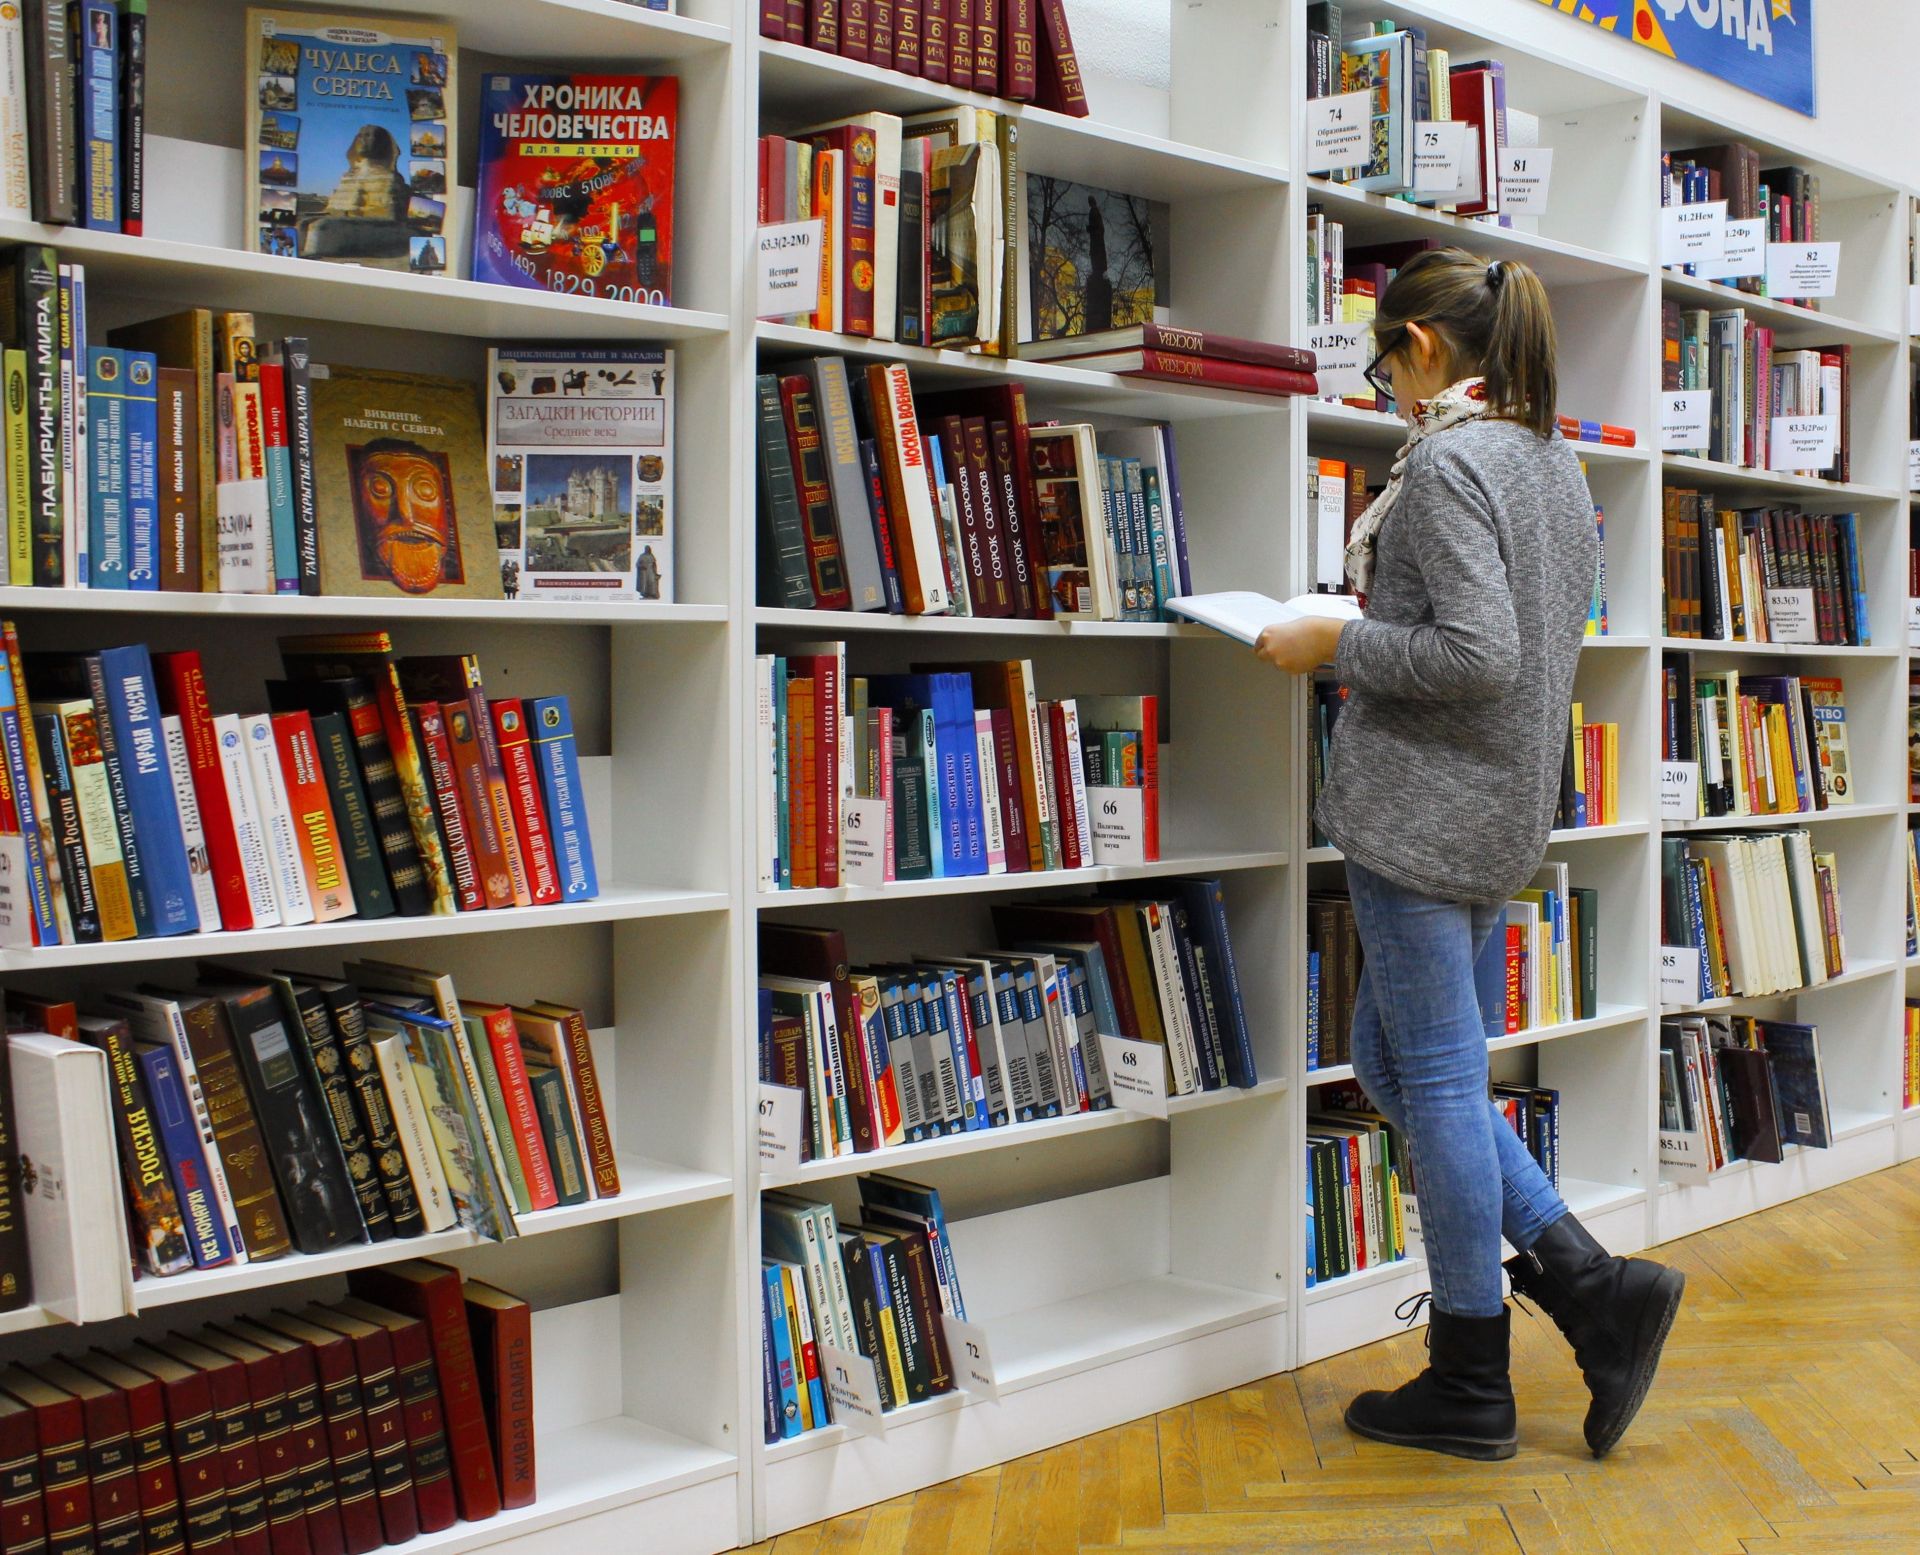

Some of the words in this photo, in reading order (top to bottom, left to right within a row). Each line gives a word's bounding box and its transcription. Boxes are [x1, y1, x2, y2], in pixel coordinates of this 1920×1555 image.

[823, 2, 833, 17] 2
[852, 2, 862, 17] 3
[904, 15, 913, 30] 5
[931, 23, 941, 37] 6
[959, 31, 968, 46] 8
[983, 34, 992, 47] 9
[305, 49, 402, 74] ЧУДЕСА
[1015, 40, 1031, 54] 10
[1061, 60, 1076, 75] 13
[313, 76, 393, 99] СВЕТА
[523, 85, 642, 110] ХРОНИКА
[493, 114, 669, 139] ЧЕЛОВЕЧЕСТВА
[1317, 124, 1359, 137] Образование.
[1329, 108, 1343, 122] 74
[525, 146, 560, 154] ДЛЯ
[577, 146, 634, 155] ДЕТЕЙ
[1328, 146, 1349, 156] наука.
[1424, 133, 1439, 146] 75
[1513, 159, 1527, 172] 81
[132, 193, 141, 213] 1000
[1678, 211, 1714, 222] 81.2Нем
[760, 232, 810, 252] 63.3(2-2М)
[1680, 231, 1711, 240] Немецкий
[510, 250, 536, 280] 1492
[768, 264, 799, 278] История
[1806, 251, 1818, 261] 82
[768, 279, 799, 291] Москвы
[36, 297, 53, 364] МИРА
[1159, 332, 1204, 351] МОСКВА
[1311, 334, 1357, 350] 81.2Рус
[1158, 357, 1203, 377] МОСКВА
[1339, 361, 1357, 370] язык
[824, 364, 849, 416] ВОЕННАЯ
[890, 368, 913, 419] ВОЕННАЯ
[173, 391, 183, 445] ВСЕМИРНАЯ
[296, 384, 310, 457] ЗАБРАЛОМ
[364, 408, 422, 423] ВИКИНГИ:
[505, 405, 577, 421] ЗАГАДКИ
[580, 405, 656, 422] ИСТОРИИ
[1673, 401, 1687, 412] 83
[14, 423, 23, 451] МИРА
[97, 418, 108, 439] МИРА
[343, 417, 389, 432] НАБЕГИ
[402, 422, 445, 437] СЕВЕРА
[544, 426, 591, 438] Средние
[594, 428, 618, 438] века
[830, 418, 856, 464] МОСКВА
[1788, 424, 1828, 433] 83.3(2Рос)
[38, 372, 57, 518] ЛАБИРИНТЫ
[98, 442, 109, 476] МОНАРХИ
[899, 421, 922, 466] МОСКВА
[16, 454, 26, 507] ДРЕВНЕГО
[175, 451, 183, 491] ИСТОРИЯ
[300, 460, 312, 523] СКРЫТЫЕ
[959, 466, 974, 526] СОРОКОВ
[979, 471, 995, 529] СОРОКОВ
[1004, 474, 1019, 532] СОРОКОВ
[1115, 493, 1124, 529] ИСТОРИЯ
[1132, 493, 1140, 531] ИСТОРИЯ
[1151, 504, 1162, 532] МИР
[16, 510, 27, 559] ИСТОРИЯ
[175, 513, 185, 573] СПРАВОЧНИК
[968, 532, 983, 576] СОРОК
[988, 535, 1003, 578] СОРОК
[1012, 538, 1027, 582] СОРОК
[1153, 535, 1167, 567] ВЕСЬ
[1772, 597, 1799, 606] 83.3(3)
[5, 716, 24, 771] ИСТОРИЯ
[18, 775, 33, 823] РОССИИ
[289, 734, 307, 784] Справочник
[298, 731, 316, 783] абитуриента
[512, 746, 531, 782] КУЛЬТУРЫ
[549, 742, 566, 775] ИСТОРИИ
[1069, 747, 1081, 785] БИЗНЕС
[554, 777, 572, 808] РУССКОЙ
[946, 754, 958, 809] МОСКВИЧИ
[964, 754, 975, 808] МОСКВИЧИ
[494, 788, 512, 832] ИМПЕРИЯ
[518, 784, 536, 814] РУССКОЙ
[931, 786, 939, 830] ЭКОНОМИКА
[1103, 800, 1117, 815] 66
[60, 797, 80, 845] России
[526, 816, 540, 832] МИР
[558, 811, 573, 826] МИР
[847, 813, 861, 828] 65
[952, 819, 960, 837] ВСЕ
[969, 818, 977, 836] ВСЕ
[1074, 798, 1090, 858] ЭКОНОМИКА
[305, 810, 340, 890] ИСТОРИЯ
[438, 790, 475, 890] ЭНЦИКЛОПЕДИЯ
[952, 840, 961, 858] МЫ
[970, 839, 979, 857] МЫ
[1093, 831, 1131, 840] Политическая
[505, 836, 525, 894] РОССИЙСКАЯ
[530, 835, 555, 898] ЭНЦИКЛОПЕДИЯ
[564, 830, 587, 893] ЭНЦИКЛОПЕДИЯ
[1693, 874, 1701, 904] ВЕКА
[1155, 934, 1169, 980] ВЫЖИВАНИЯ
[1662, 956, 1675, 966] 85
[1700, 929, 1714, 995] ИСКУССТВО
[950, 994, 963, 1044] ПРЕСТУПЛЕНИЯ
[1165, 982, 1183, 1041] ЭНЦИКЛОПЕДИЯ
[570, 1017, 589, 1064] КУЛЬТУРЫ
[107, 1035, 129, 1083] МОНАРХИ
[121, 1051, 138, 1083] МИРА
[828, 1024, 843, 1096] ПРИЗЫВНИКА
[1017, 1056, 1032, 1093] АДВОКАТУ
[1121, 1051, 1137, 1067] 68
[1176, 1041, 1189, 1076] БОЛЬШАЯ
[579, 1067, 599, 1113] РУССКОЙ
[939, 1057, 959, 1117] ЖЕНЩИНАМ
[958, 1054, 971, 1100] ПРЕСТУПНИКИ
[988, 1063, 1002, 1094] ДЕТЯХ
[1035, 1049, 1055, 1101] ПРАВОСУДИЕ
[118, 1086, 134, 1106] ВСЕ
[759, 1099, 774, 1117] 67
[126, 1107, 163, 1186] РОССИЯ
[588, 1116, 609, 1164] ИСТОРИЯ
[1660, 1140, 1689, 1152] 85.11
[524, 1131, 551, 1198] ТЫСЯЧЕЛЕТИЕ
[187, 1189, 215, 1239] МОНАРХИ
[1336, 1211, 1344, 1252] ИНОСТРАННЫХ
[200, 1239, 221, 1261] ВСЕ
[888, 1254, 899, 1286] СЛОВАРЬ
[893, 1287, 915, 1372] ЭНЦИКЛОПЕДИЧЕСКИЙ
[966, 1342, 980, 1359] 72
[511, 1336, 525, 1412] ПАМЯТЬ
[836, 1367, 849, 1385] 71
[971, 1370, 990, 1385] Наука
[514, 1415, 531, 1482] ЖИВАЯ
